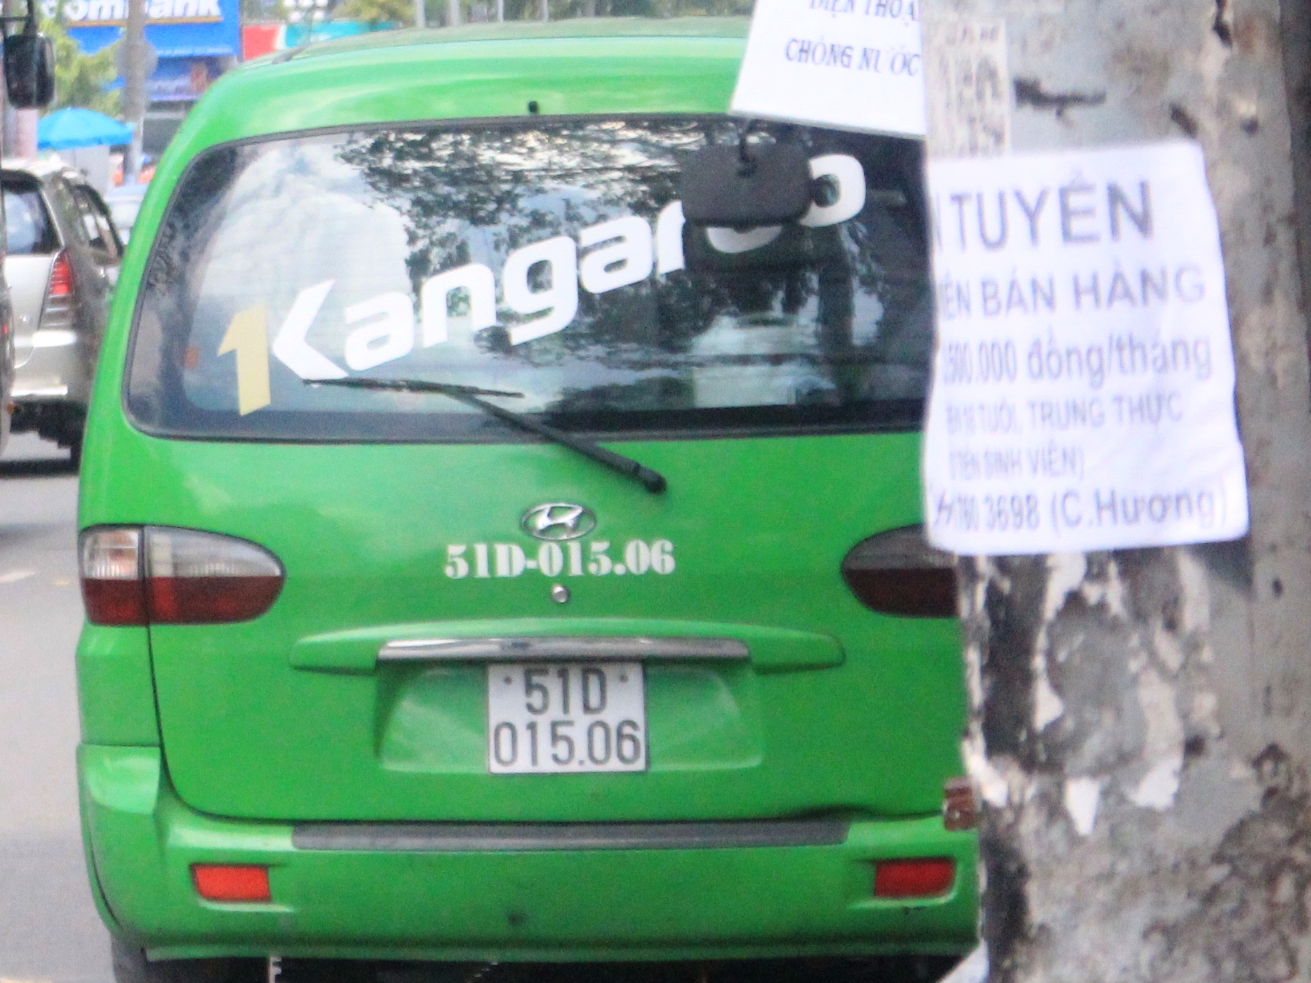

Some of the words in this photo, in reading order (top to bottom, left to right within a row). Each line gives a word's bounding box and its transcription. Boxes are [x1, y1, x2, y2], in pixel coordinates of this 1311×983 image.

[444, 539, 676, 579] 51D-015.06
[523, 666, 608, 716] 51D
[493, 719, 642, 767] 015.06
